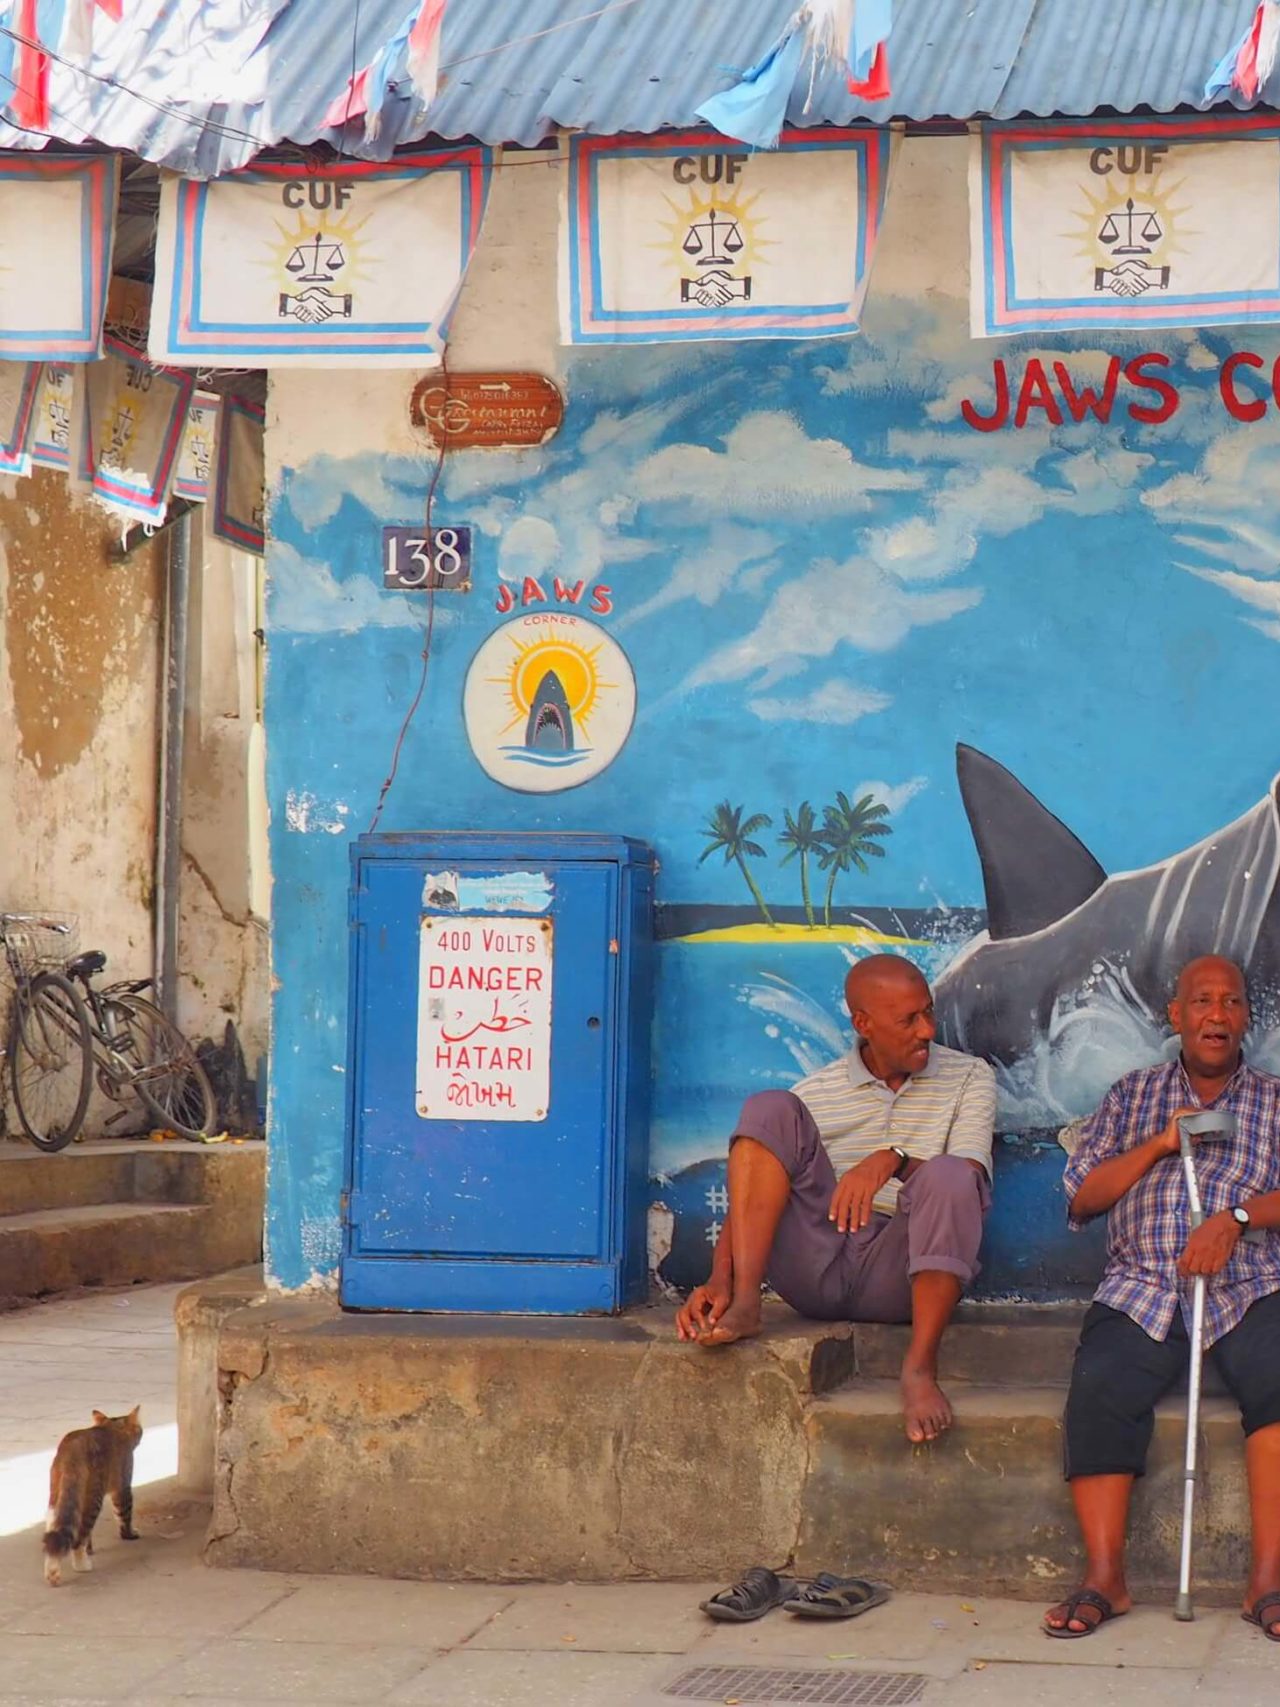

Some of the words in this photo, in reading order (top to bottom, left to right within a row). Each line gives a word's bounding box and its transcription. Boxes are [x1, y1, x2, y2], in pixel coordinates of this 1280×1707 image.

[673, 153, 748, 184] CUF
[1090, 145, 1168, 175] CUF
[282, 181, 355, 210] CUF
[961, 352, 1181, 432] JAWS
[384, 529, 462, 585] 138
[496, 577, 613, 614] JAWS
[524, 615, 578, 627] CORNER
[437, 931, 471, 952] 400
[429, 966, 543, 992] DANGER
[436, 1046, 531, 1070] HATARI
